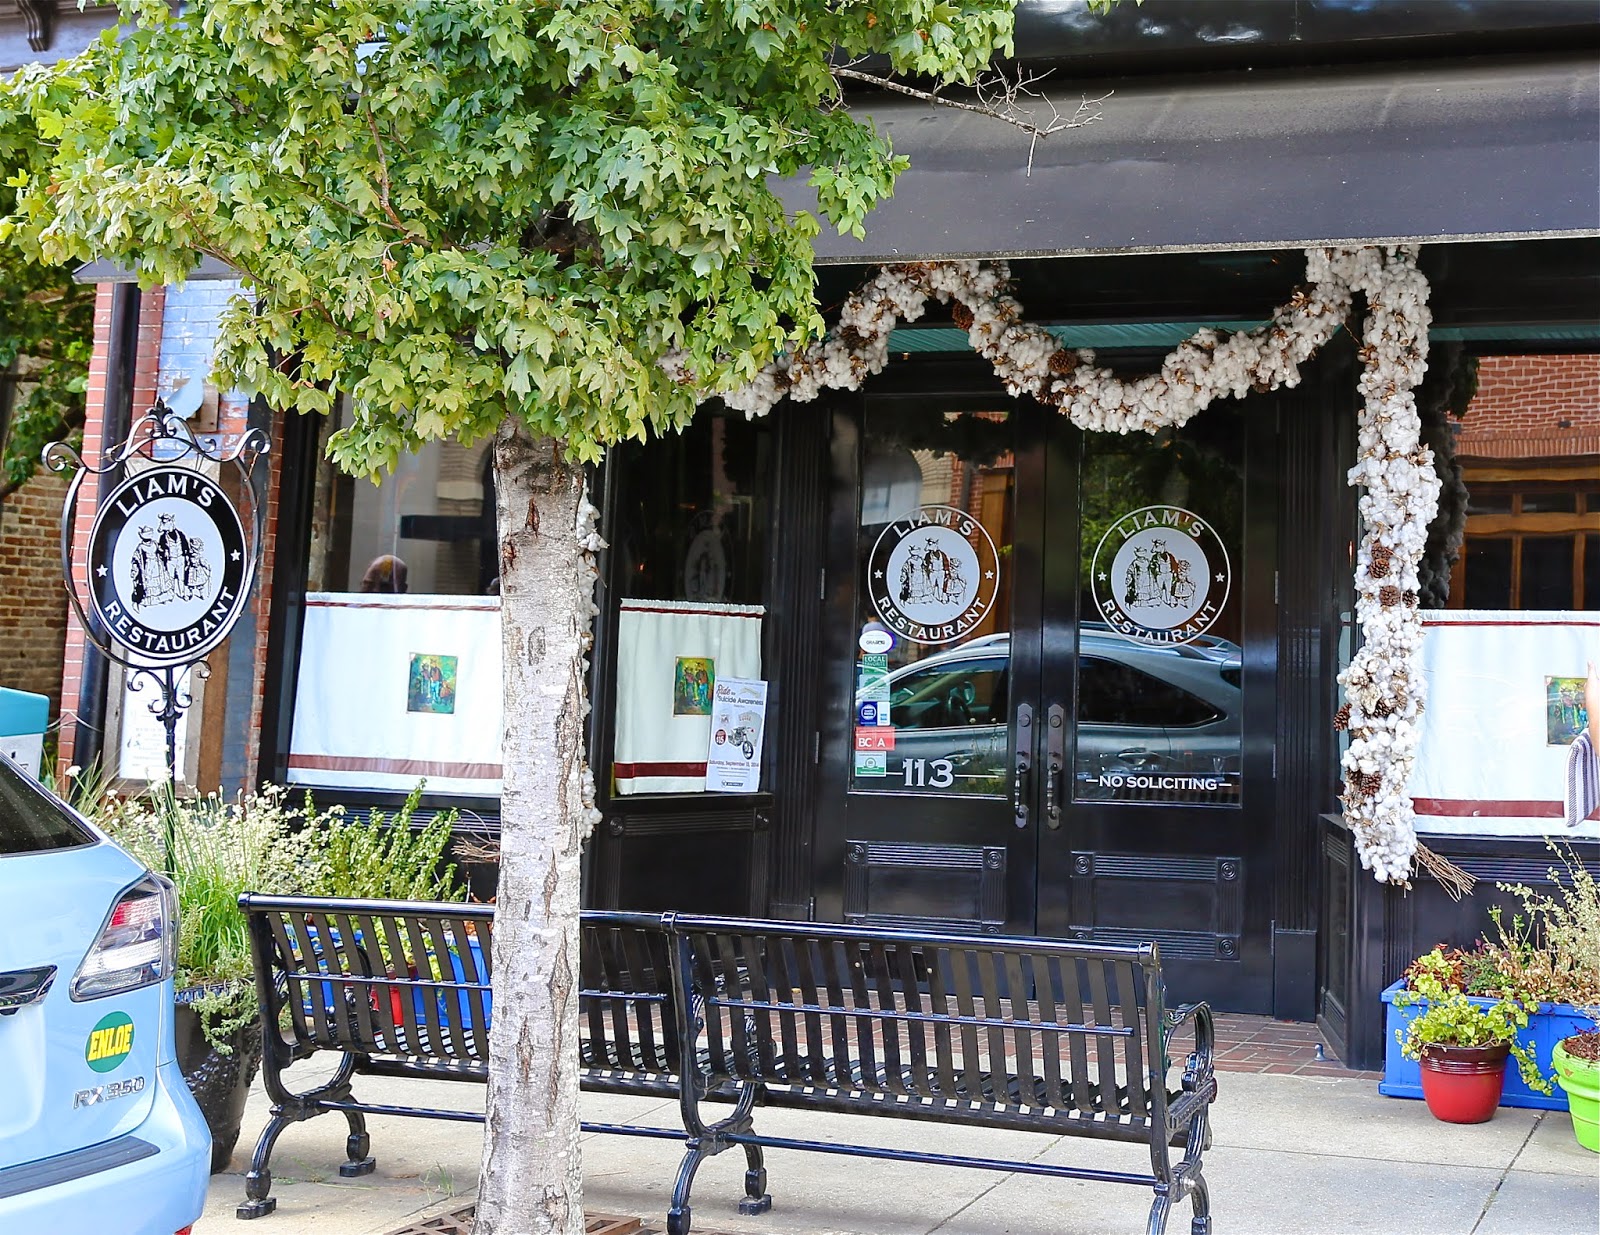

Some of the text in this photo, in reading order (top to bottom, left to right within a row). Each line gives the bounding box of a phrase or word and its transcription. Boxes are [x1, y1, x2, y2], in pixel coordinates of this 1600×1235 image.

[116, 474, 217, 517] LIAM'S
[892, 509, 975, 538] LIAM'S
[1117, 510, 1205, 539] LIAM'S
[104, 586, 235, 651] RESTAURANT
[878, 596, 986, 640] RESTAURANT
[1102, 599, 1217, 643] RESTAURANT
[737, 697, 764, 706] Awareness
[902, 758, 954, 788] 113
[1099, 775, 1218, 790] NO SOLICITING
[87, 1023, 134, 1062] ENLOE
